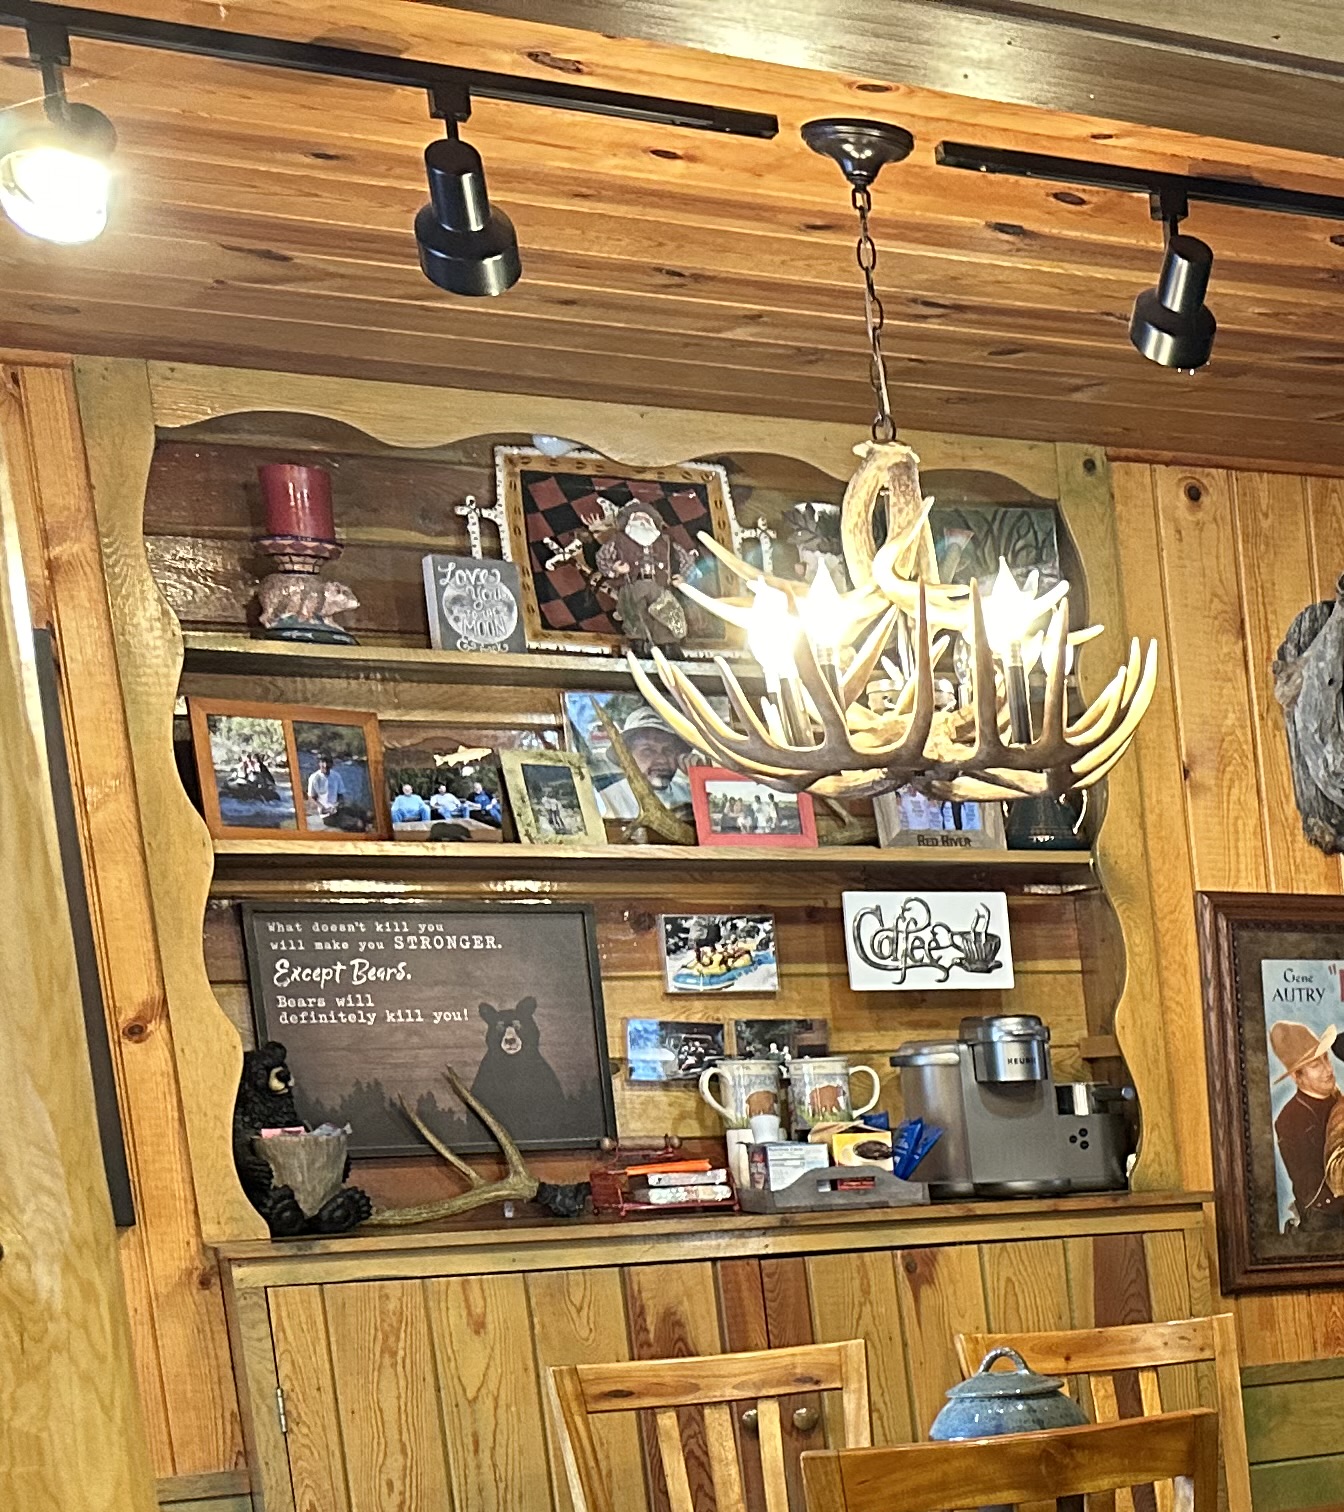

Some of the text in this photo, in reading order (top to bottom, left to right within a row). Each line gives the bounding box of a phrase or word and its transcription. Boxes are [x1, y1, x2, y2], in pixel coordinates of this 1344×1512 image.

[438, 562, 501, 586] Love
[461, 616, 508, 638] MOON
[917, 834, 972, 847] RED RIVER
[267, 921, 445, 933] What doesn't kill you
[270, 935, 503, 951] will make you STRONGER.
[273, 958, 412, 989] Except Bears.
[1283, 968, 1314, 984] Gene
[276, 994, 375, 1008] Bears will
[1272, 987, 1325, 1006] AUTRY
[279, 1008, 469, 1025] definitely kill you!
